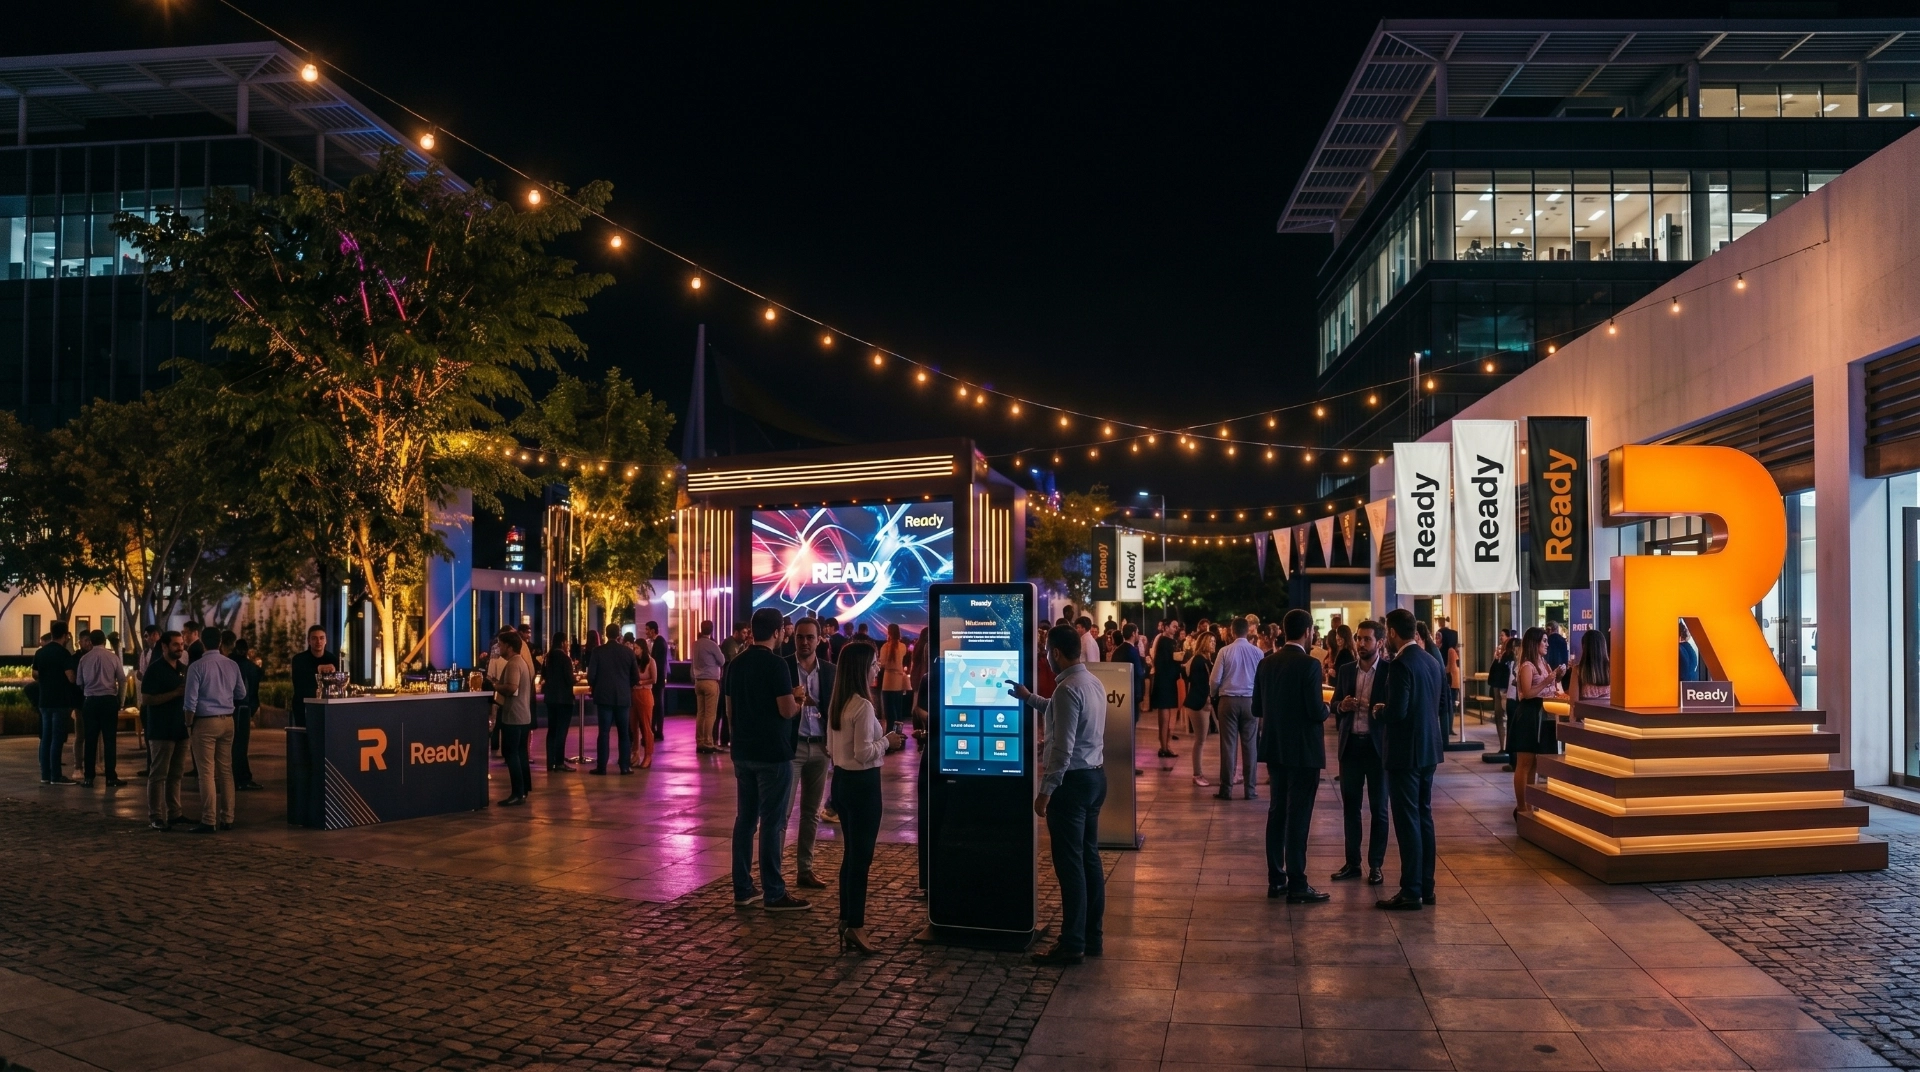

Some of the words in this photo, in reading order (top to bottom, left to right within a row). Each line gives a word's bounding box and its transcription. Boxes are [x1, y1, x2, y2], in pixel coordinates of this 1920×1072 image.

[905, 513, 944, 529] Ready
[1411, 472, 1440, 568] Ready
[1471, 454, 1504, 563] Ready
[1543, 448, 1577, 562] Ready
[812, 560, 891, 584] READY
[1608, 444, 1798, 708] R
[1686, 688, 1728, 703] Ready
[357, 728, 388, 772] R
[410, 739, 471, 766] Ready
